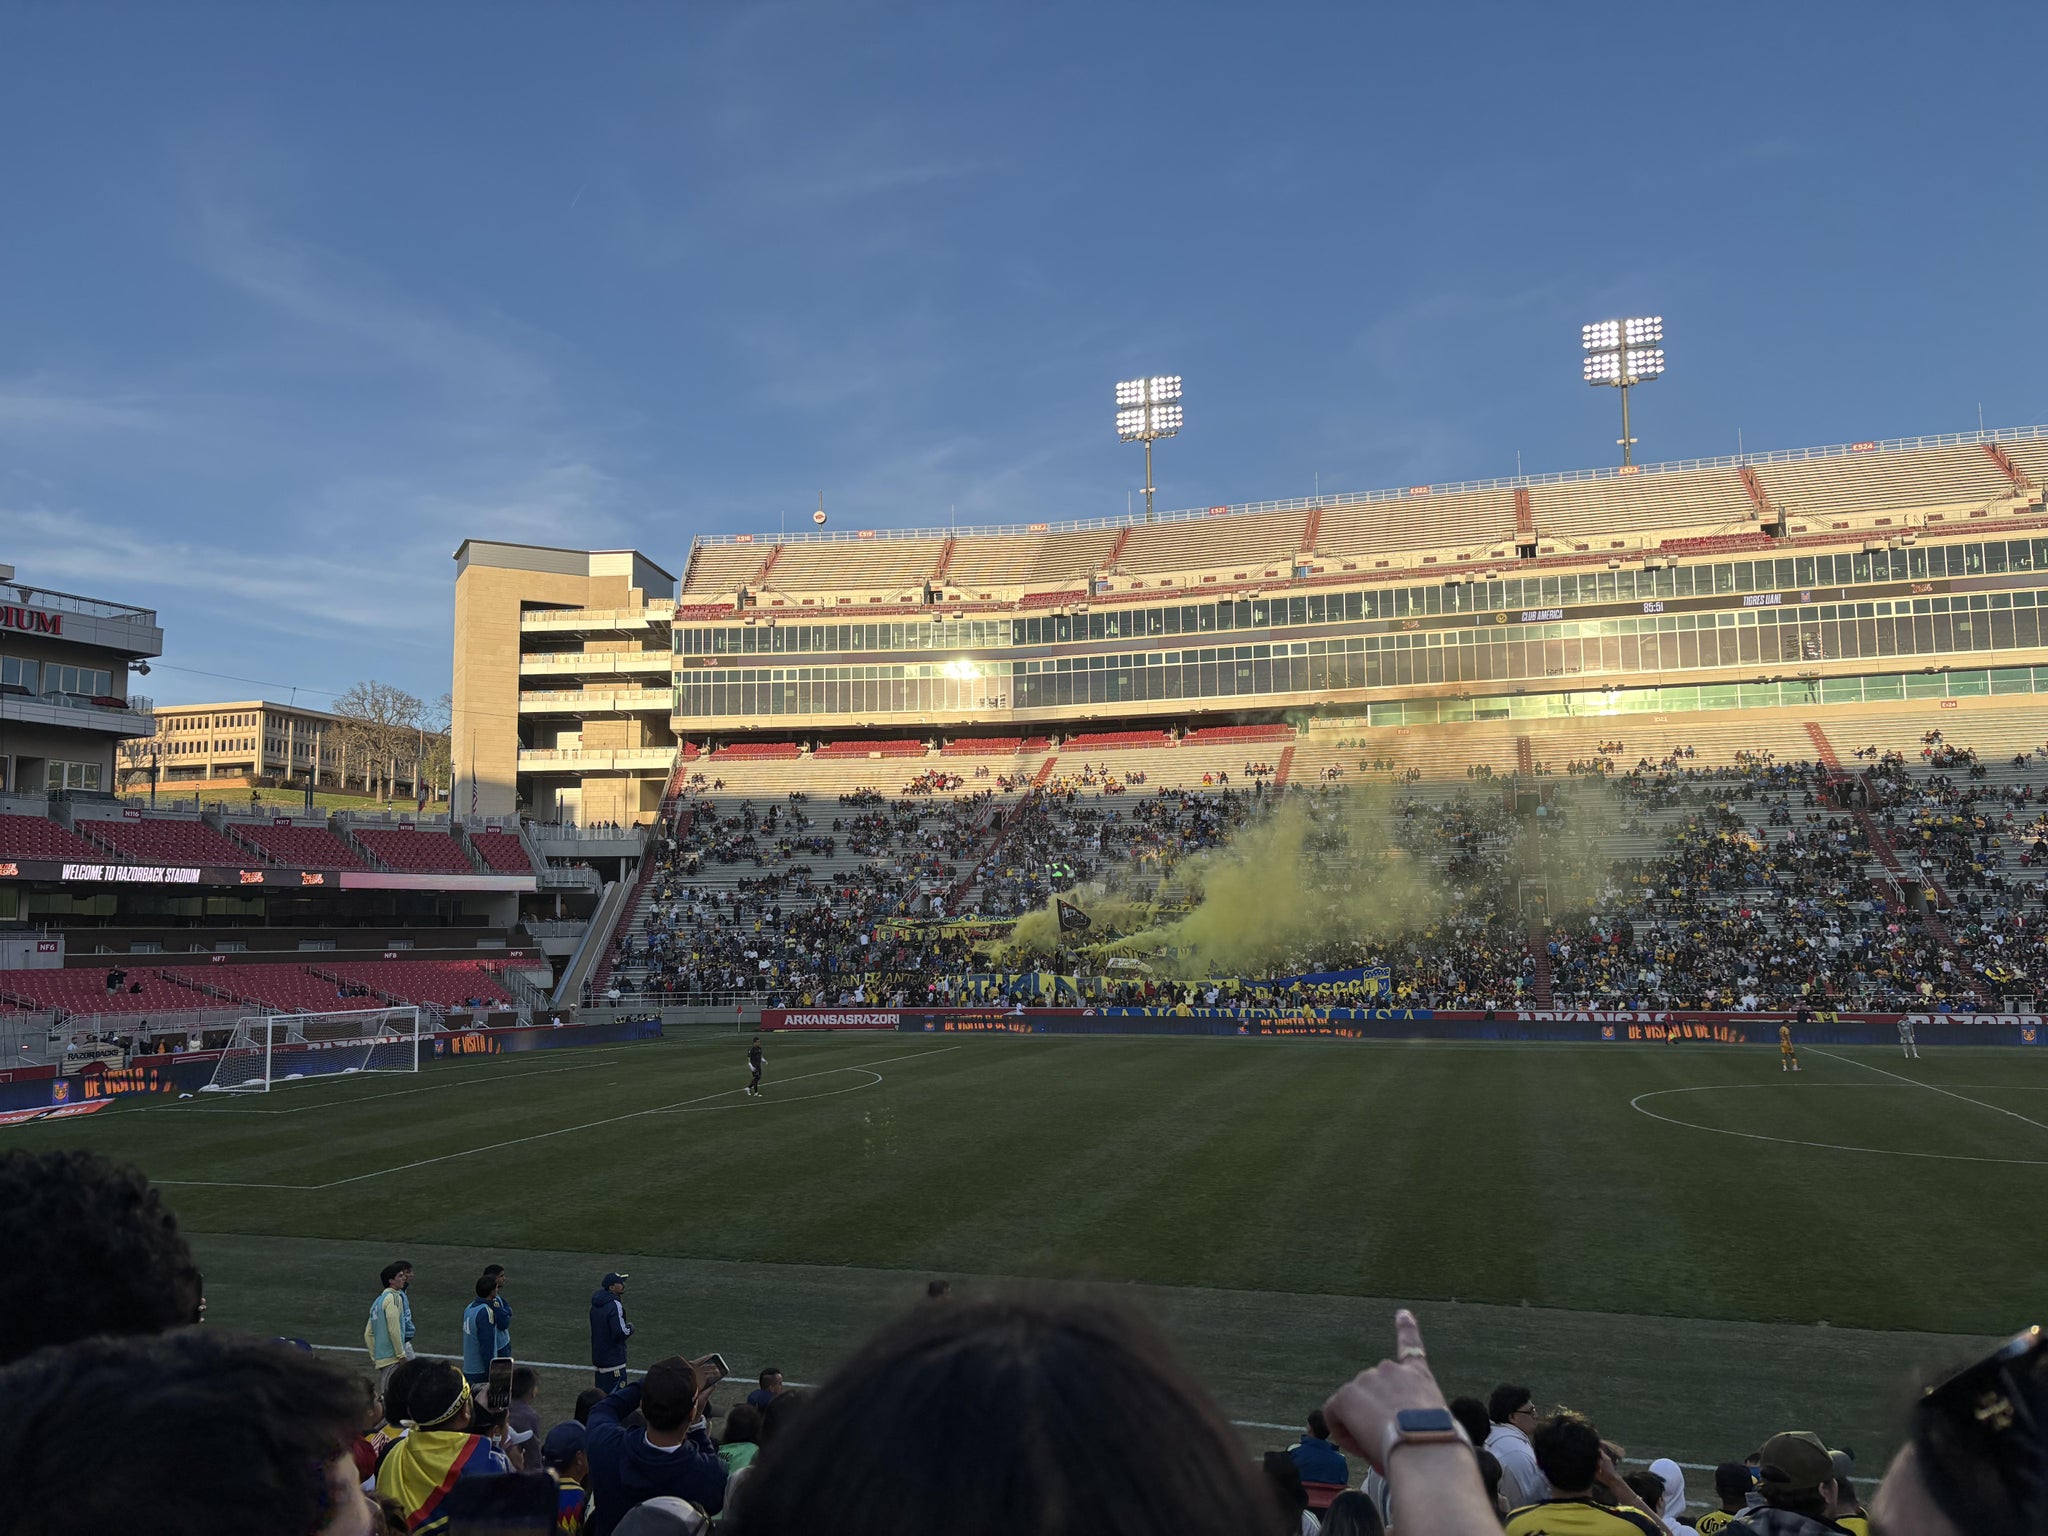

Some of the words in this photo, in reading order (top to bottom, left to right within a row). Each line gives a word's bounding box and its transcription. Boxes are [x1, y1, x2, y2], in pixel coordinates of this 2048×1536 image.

[1743, 594, 1765, 606] TIGRES
[1521, 611, 1537, 622] CLUB
[61, 864, 103, 881] WELCOME
[104, 865, 115, 881] TO
[115, 866, 164, 883] RAZORBACK
[165, 868, 201, 883] STADIUM
